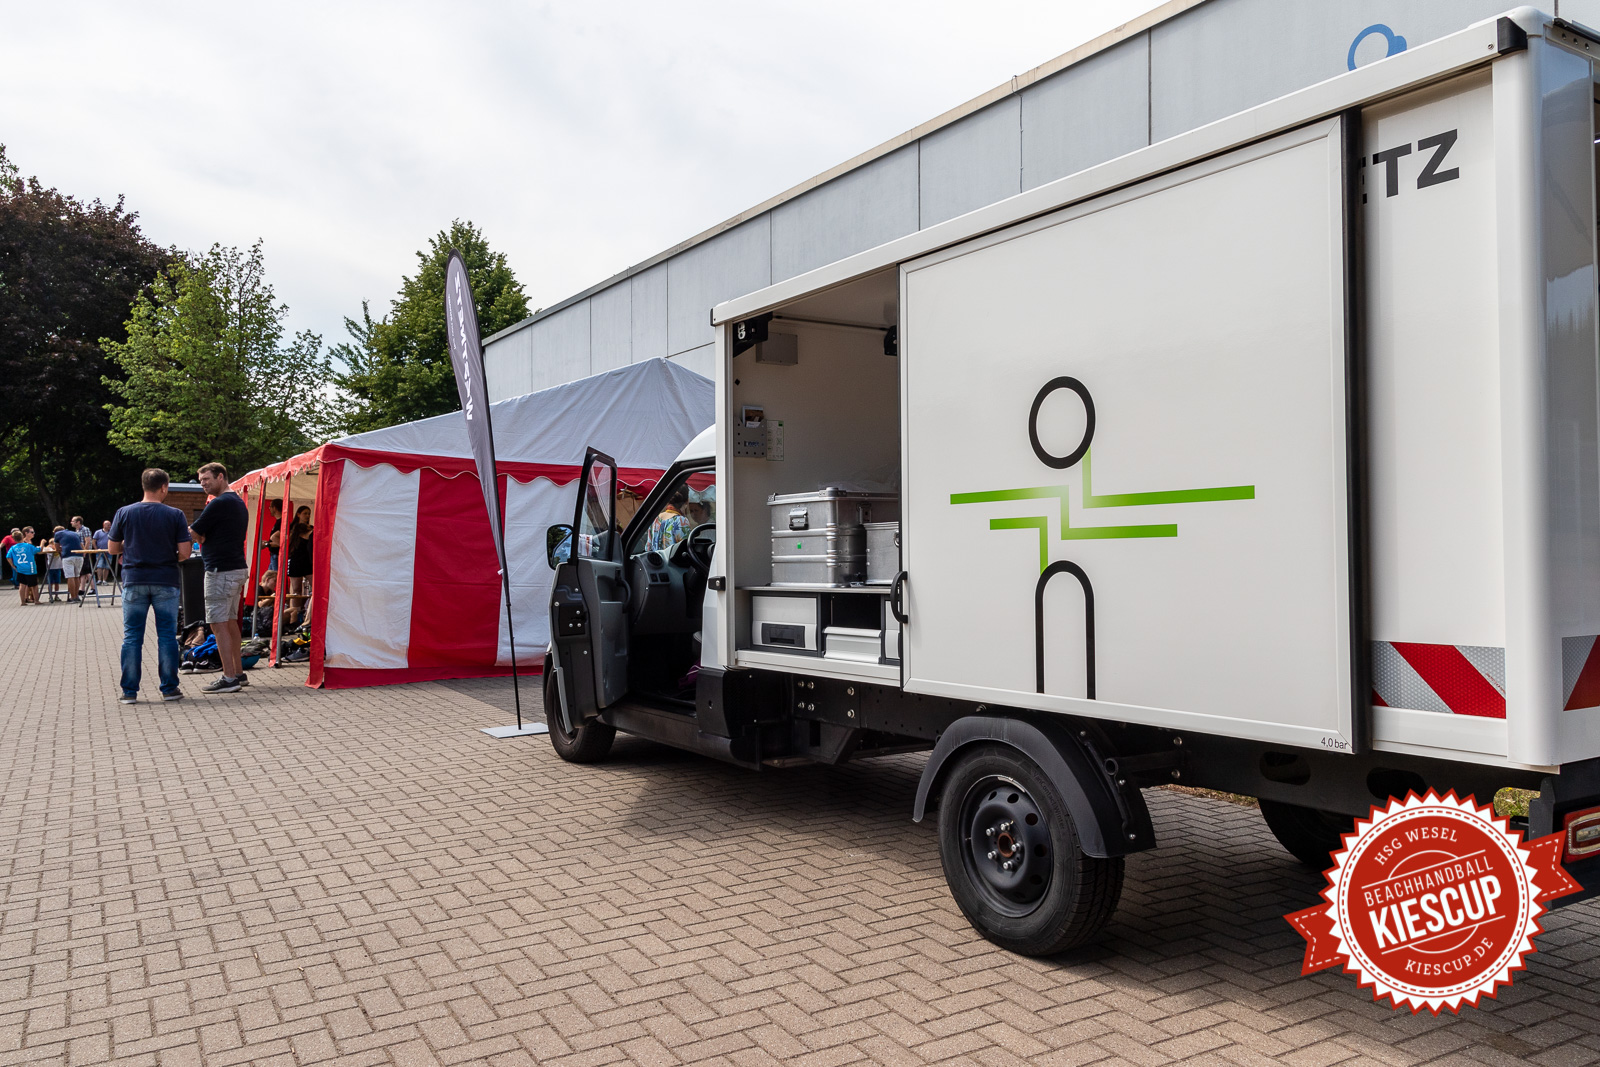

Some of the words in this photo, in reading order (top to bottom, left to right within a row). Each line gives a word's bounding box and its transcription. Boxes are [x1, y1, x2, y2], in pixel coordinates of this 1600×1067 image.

[1362, 128, 1460, 205] TZ
[16, 554, 28, 564] 22
[1321, 737, 1333, 747] 4,0
[1335, 739, 1348, 749] bar
